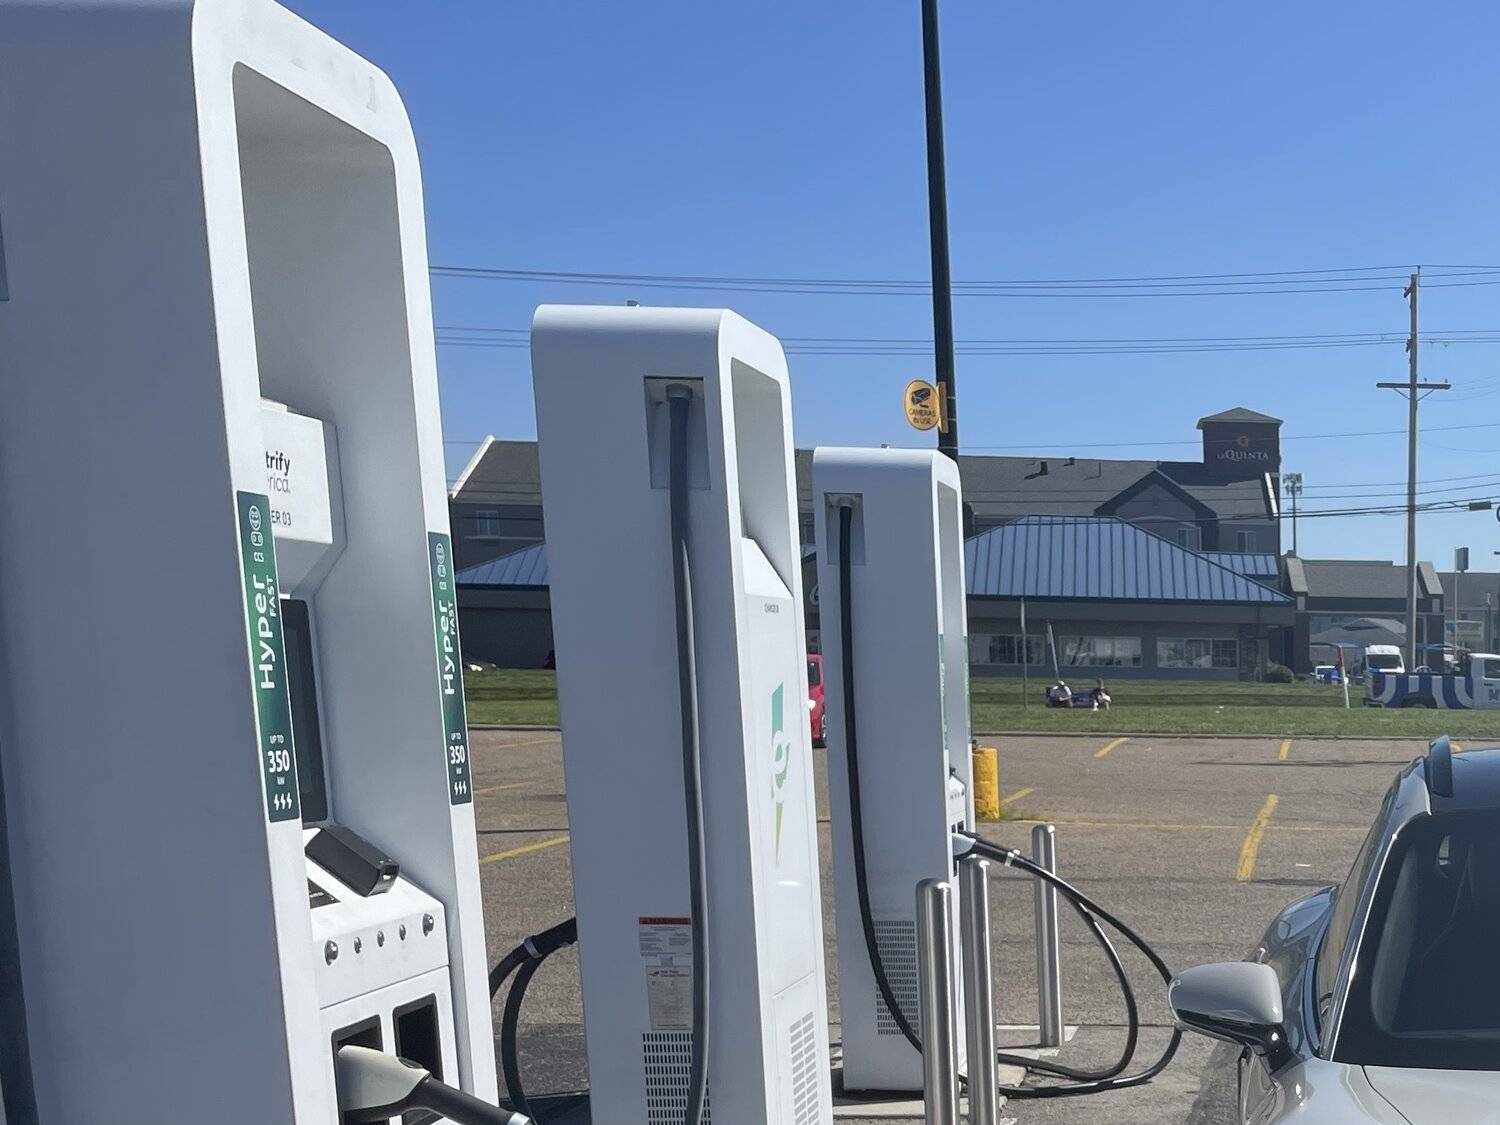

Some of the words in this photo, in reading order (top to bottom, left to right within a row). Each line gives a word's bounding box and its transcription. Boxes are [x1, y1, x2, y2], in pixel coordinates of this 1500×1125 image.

[282, 512, 292, 526] 03
[266, 574, 277, 617] FAST
[447, 601, 456, 635] FAST
[267, 749, 290, 773] 350
[449, 745, 465, 765] 350
